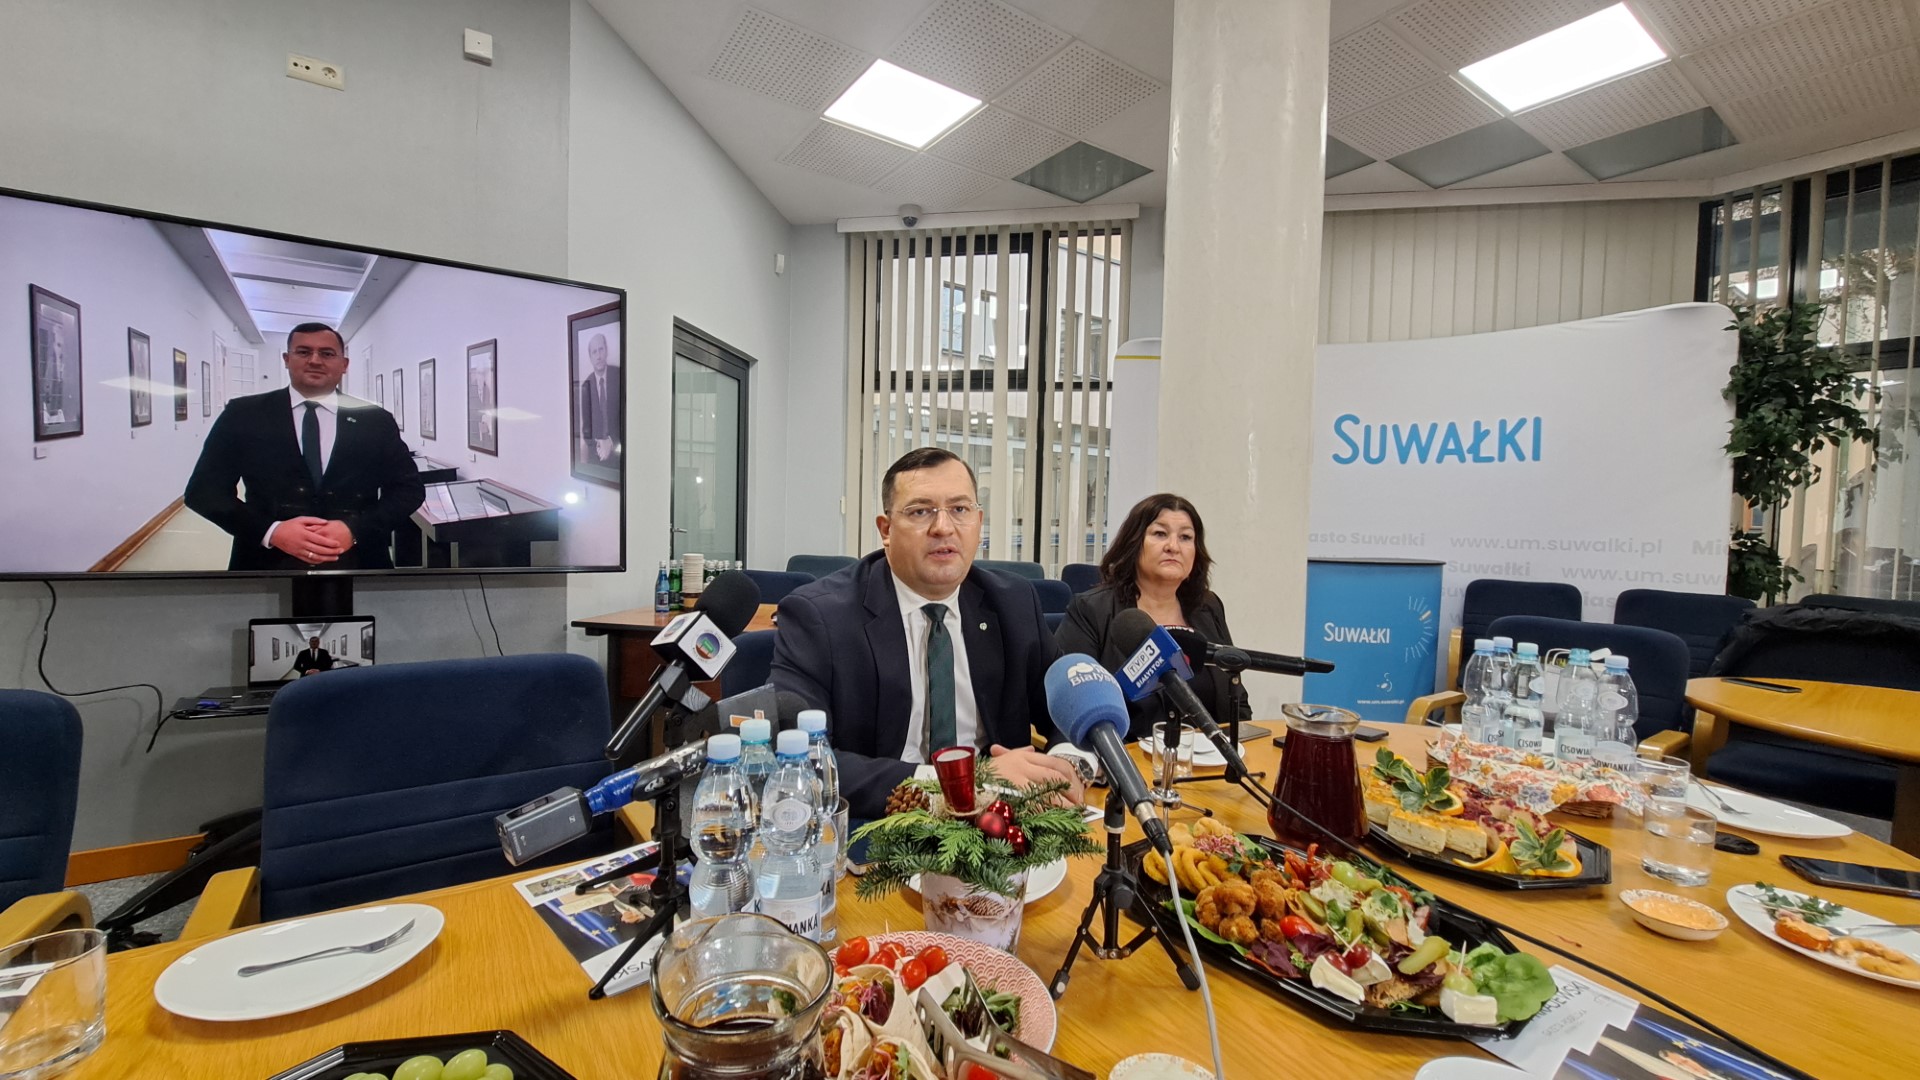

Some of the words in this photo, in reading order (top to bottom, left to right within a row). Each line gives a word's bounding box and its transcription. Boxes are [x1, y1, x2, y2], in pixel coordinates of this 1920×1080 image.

[1332, 413, 1542, 465] SUWAŁKI
[1308, 533, 1347, 544] asto
[1350, 532, 1425, 547] Suwałki
[1448, 560, 1531, 576] Suwałki
[1562, 566, 1726, 586] www.um.suw
[1323, 622, 1391, 644] SUWAŁKI
